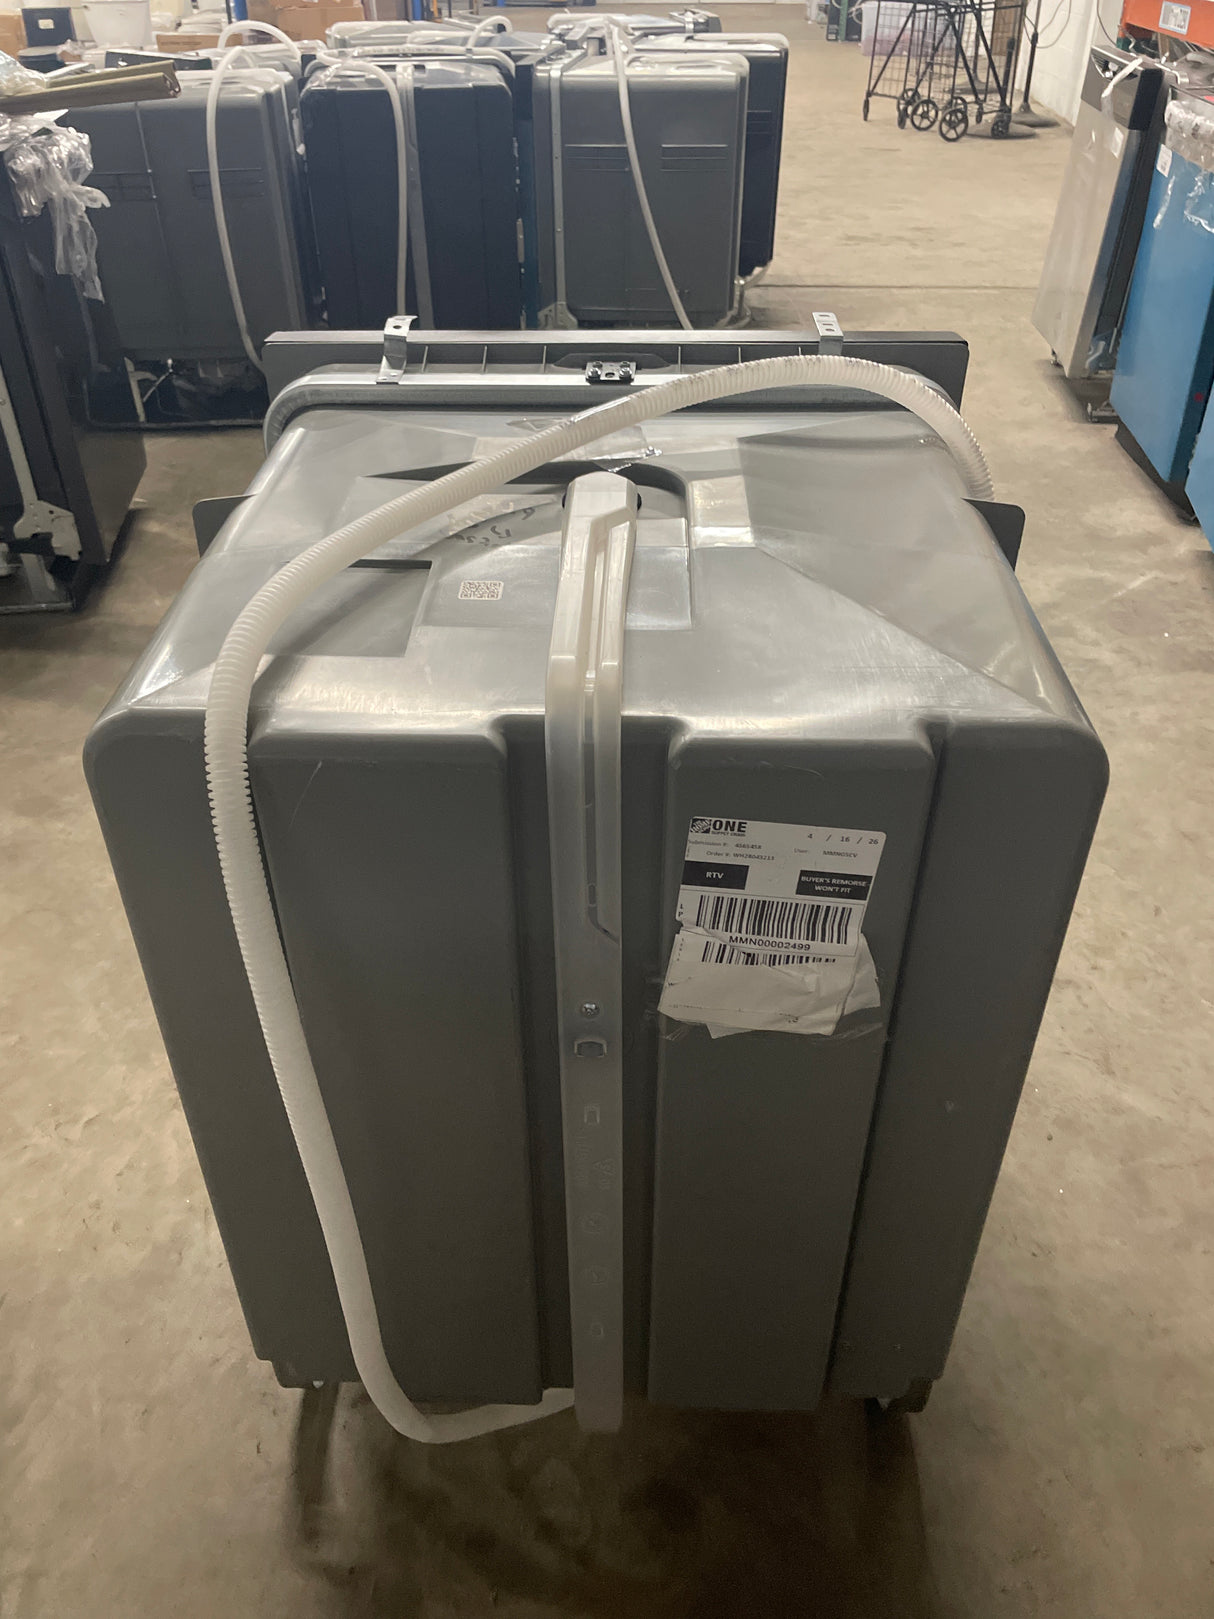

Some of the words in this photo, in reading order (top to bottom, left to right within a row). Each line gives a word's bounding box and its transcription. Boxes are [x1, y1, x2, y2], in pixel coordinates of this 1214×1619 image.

[712, 819, 747, 833] ONE
[826, 834, 832, 842] /
[857, 836, 863, 844] /
[705, 871, 724, 879] RTV
[801, 875, 830, 884] BUYER'S
[831, 878, 868, 887] REMORSE
[814, 885, 839, 893] WON'T
[729, 935, 811, 951] MMN00002499
